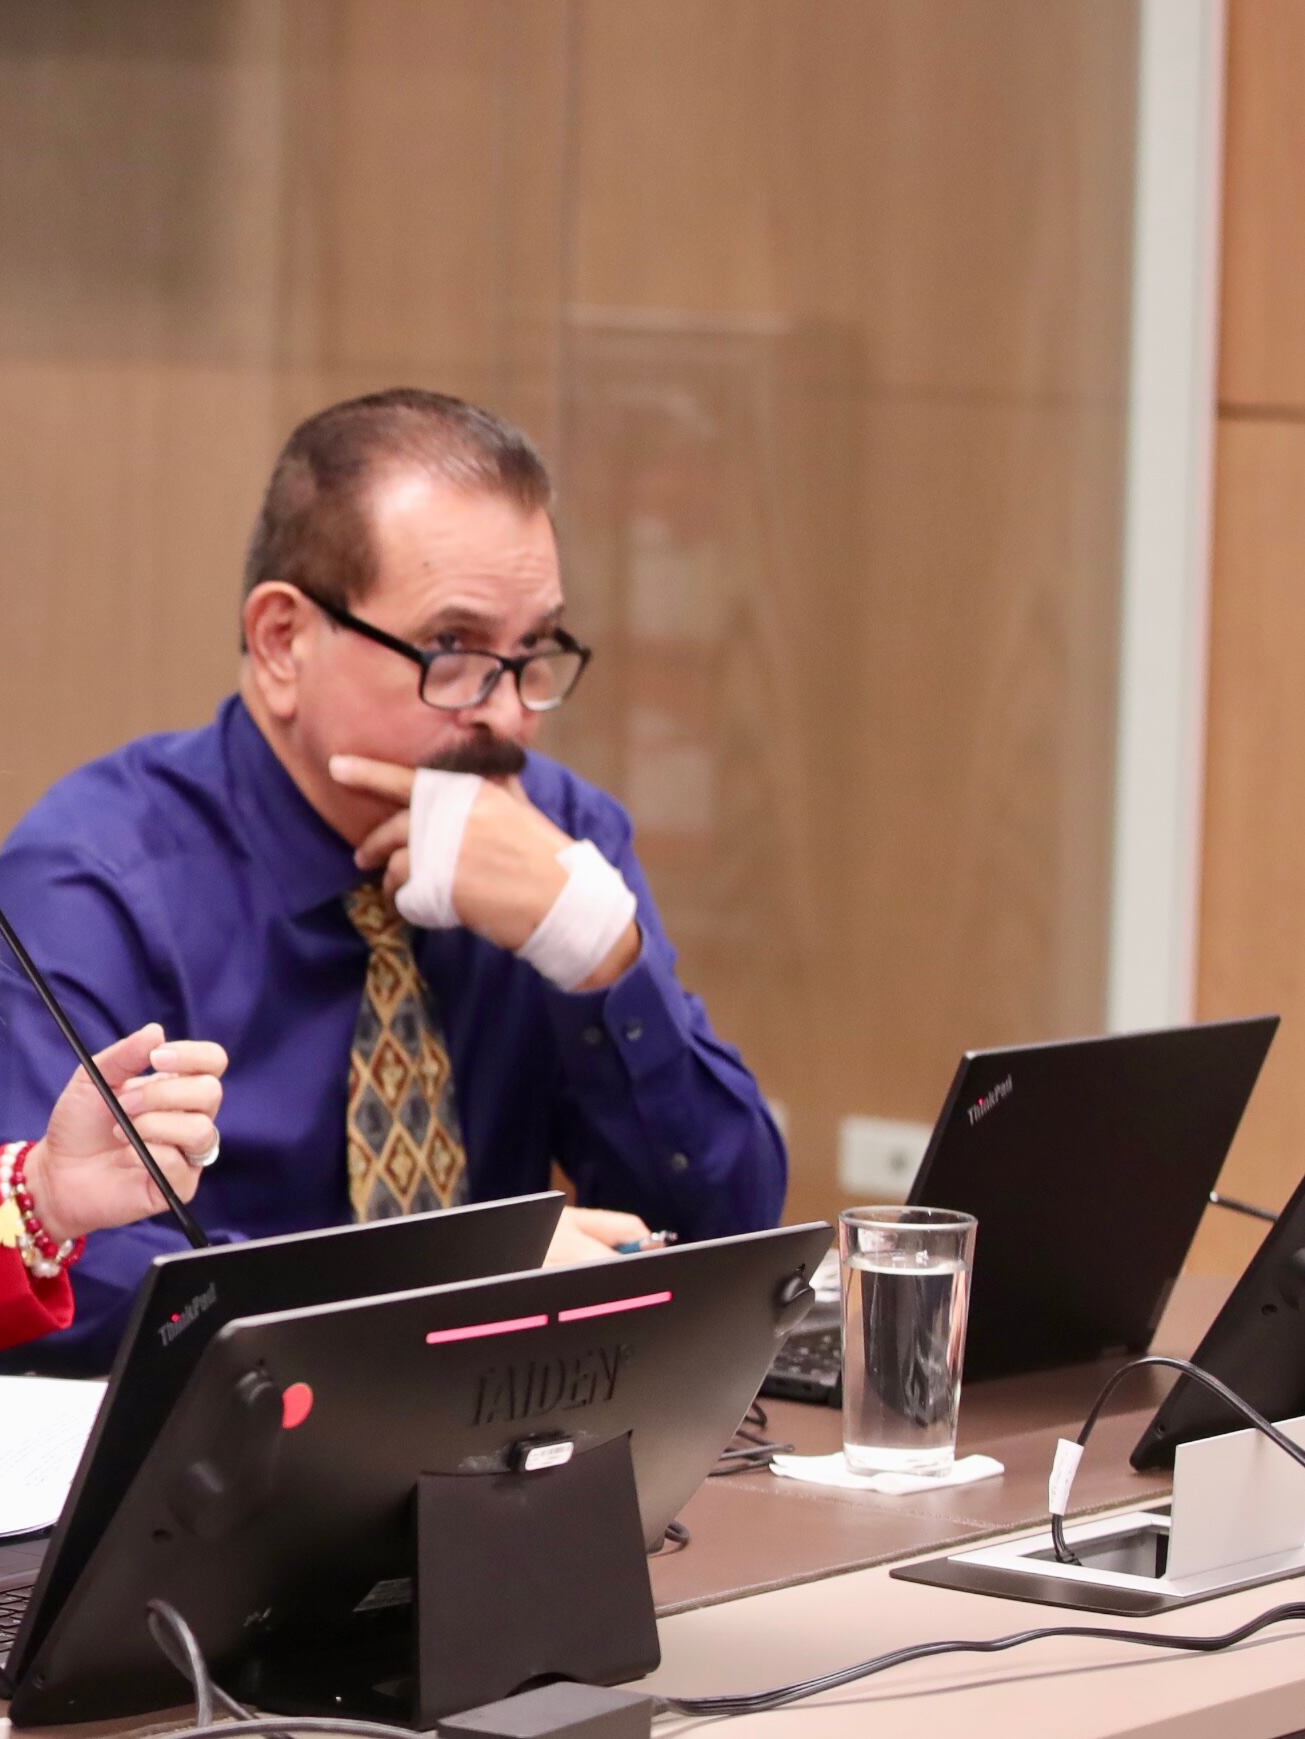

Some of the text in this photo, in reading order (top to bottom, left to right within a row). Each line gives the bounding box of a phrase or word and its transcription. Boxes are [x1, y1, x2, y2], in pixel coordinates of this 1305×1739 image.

[968, 1073, 1013, 1126] ThinkPad
[158, 1281, 216, 1347] ThinkPad
[470, 1345, 623, 1426] TAIDEN
